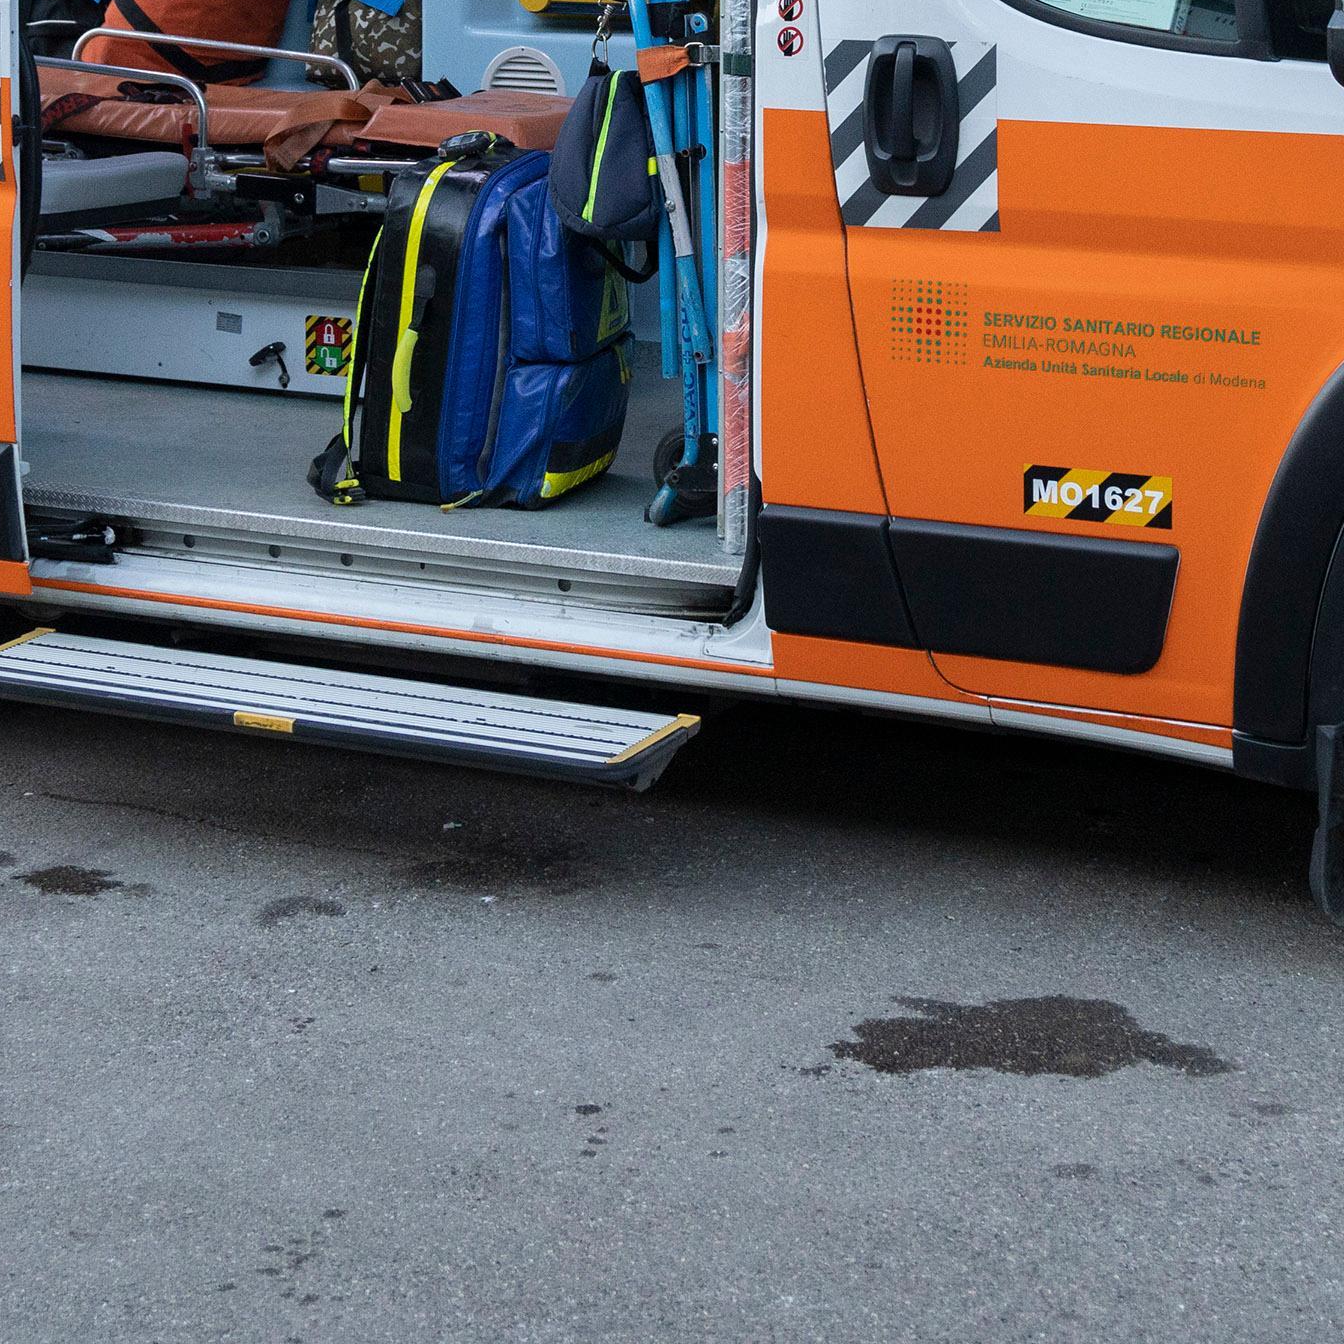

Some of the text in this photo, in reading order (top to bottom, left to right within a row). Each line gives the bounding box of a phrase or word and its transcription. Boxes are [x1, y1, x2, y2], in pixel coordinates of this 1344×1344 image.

[982, 333, 1137, 358] EMILIA-ROMAGNA
[983, 311, 1262, 346] SERVIZIO SANITARIO REGIONALE
[983, 355, 1267, 390] Azienda Unità Sanitaria Locale di Modena
[1031, 477, 1165, 516] MO1627
